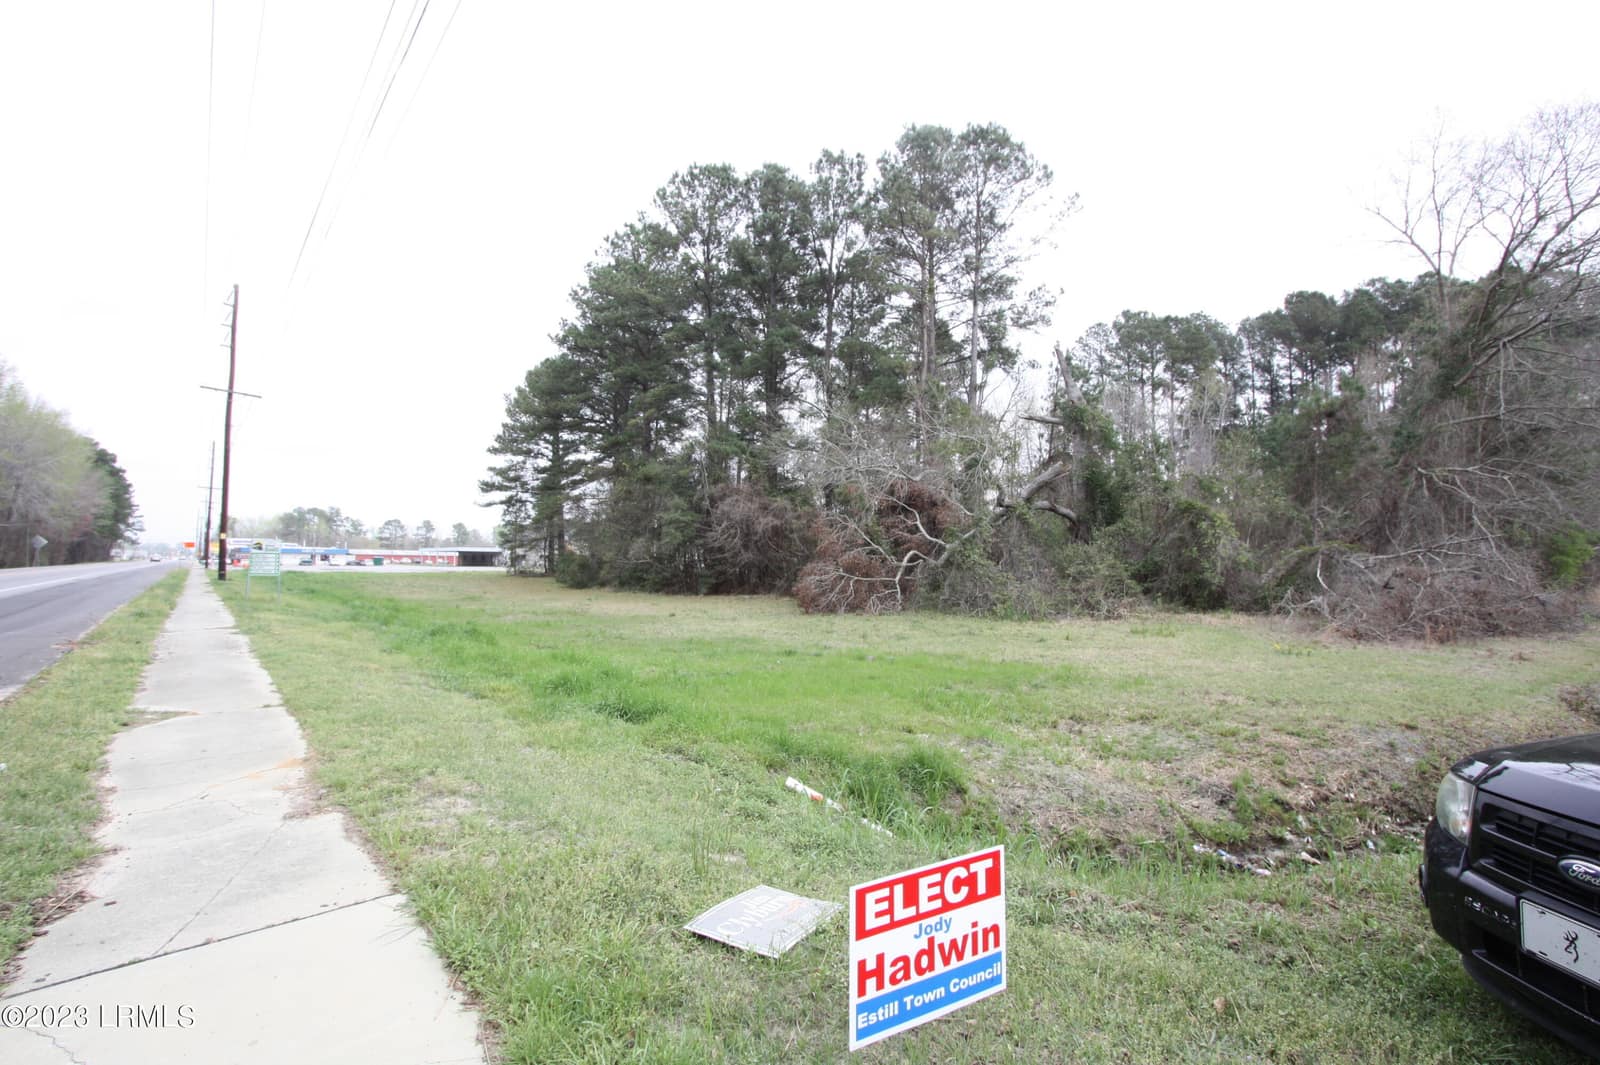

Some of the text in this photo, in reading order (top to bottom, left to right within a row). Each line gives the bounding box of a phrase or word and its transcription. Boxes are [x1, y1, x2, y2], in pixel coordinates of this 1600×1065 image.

[865, 858, 993, 931] ELECT
[913, 916, 952, 939] Jody
[857, 920, 1000, 998] Hadwin
[857, 962, 1002, 1029] Estill Town Council
